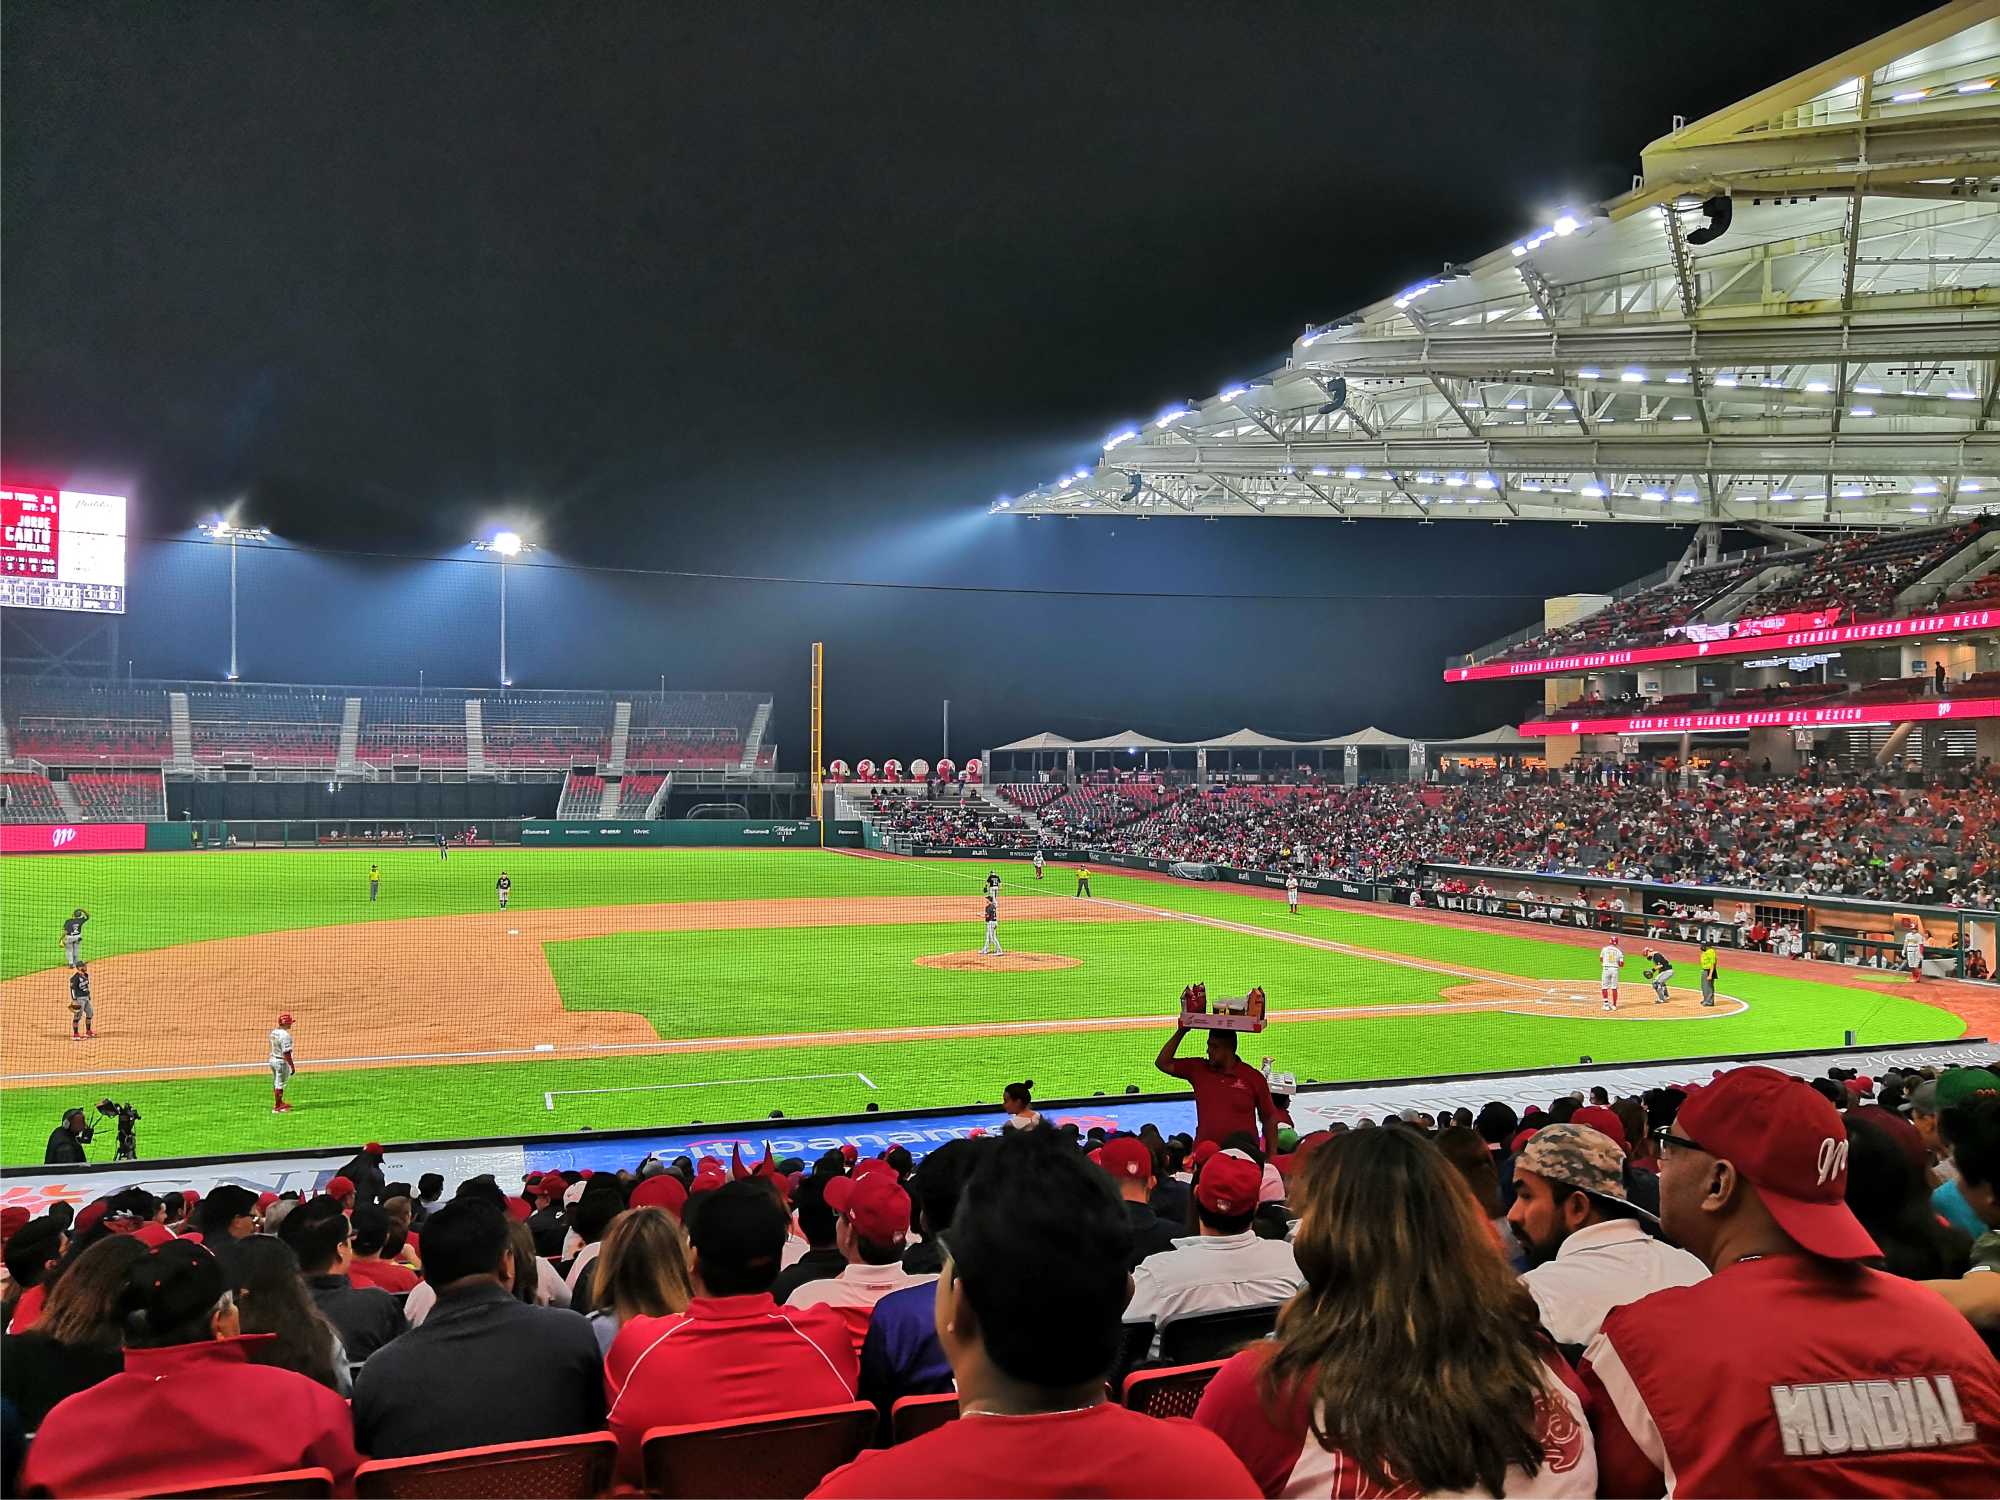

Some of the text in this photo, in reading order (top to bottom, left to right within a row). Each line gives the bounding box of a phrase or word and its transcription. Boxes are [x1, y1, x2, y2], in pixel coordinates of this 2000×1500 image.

[1787, 631, 1838, 645] ESTADIO
[1845, 623, 1902, 639] ALFREDO
[1910, 618, 1945, 632] HARP
[1510, 662, 1542, 674] ESTADIO
[1546, 659, 1580, 670] ALFREDO
[1629, 719, 1652, 730] CASA
[1657, 718, 1669, 729] DE
[1674, 717, 1692, 728] LOS
[1697, 714, 1741, 726] DIABLOS
[1747, 712, 1781, 724] ROJOS
[1787, 711, 1808, 722] DEL
[1771, 1374, 1977, 1456] MUNDIAL
